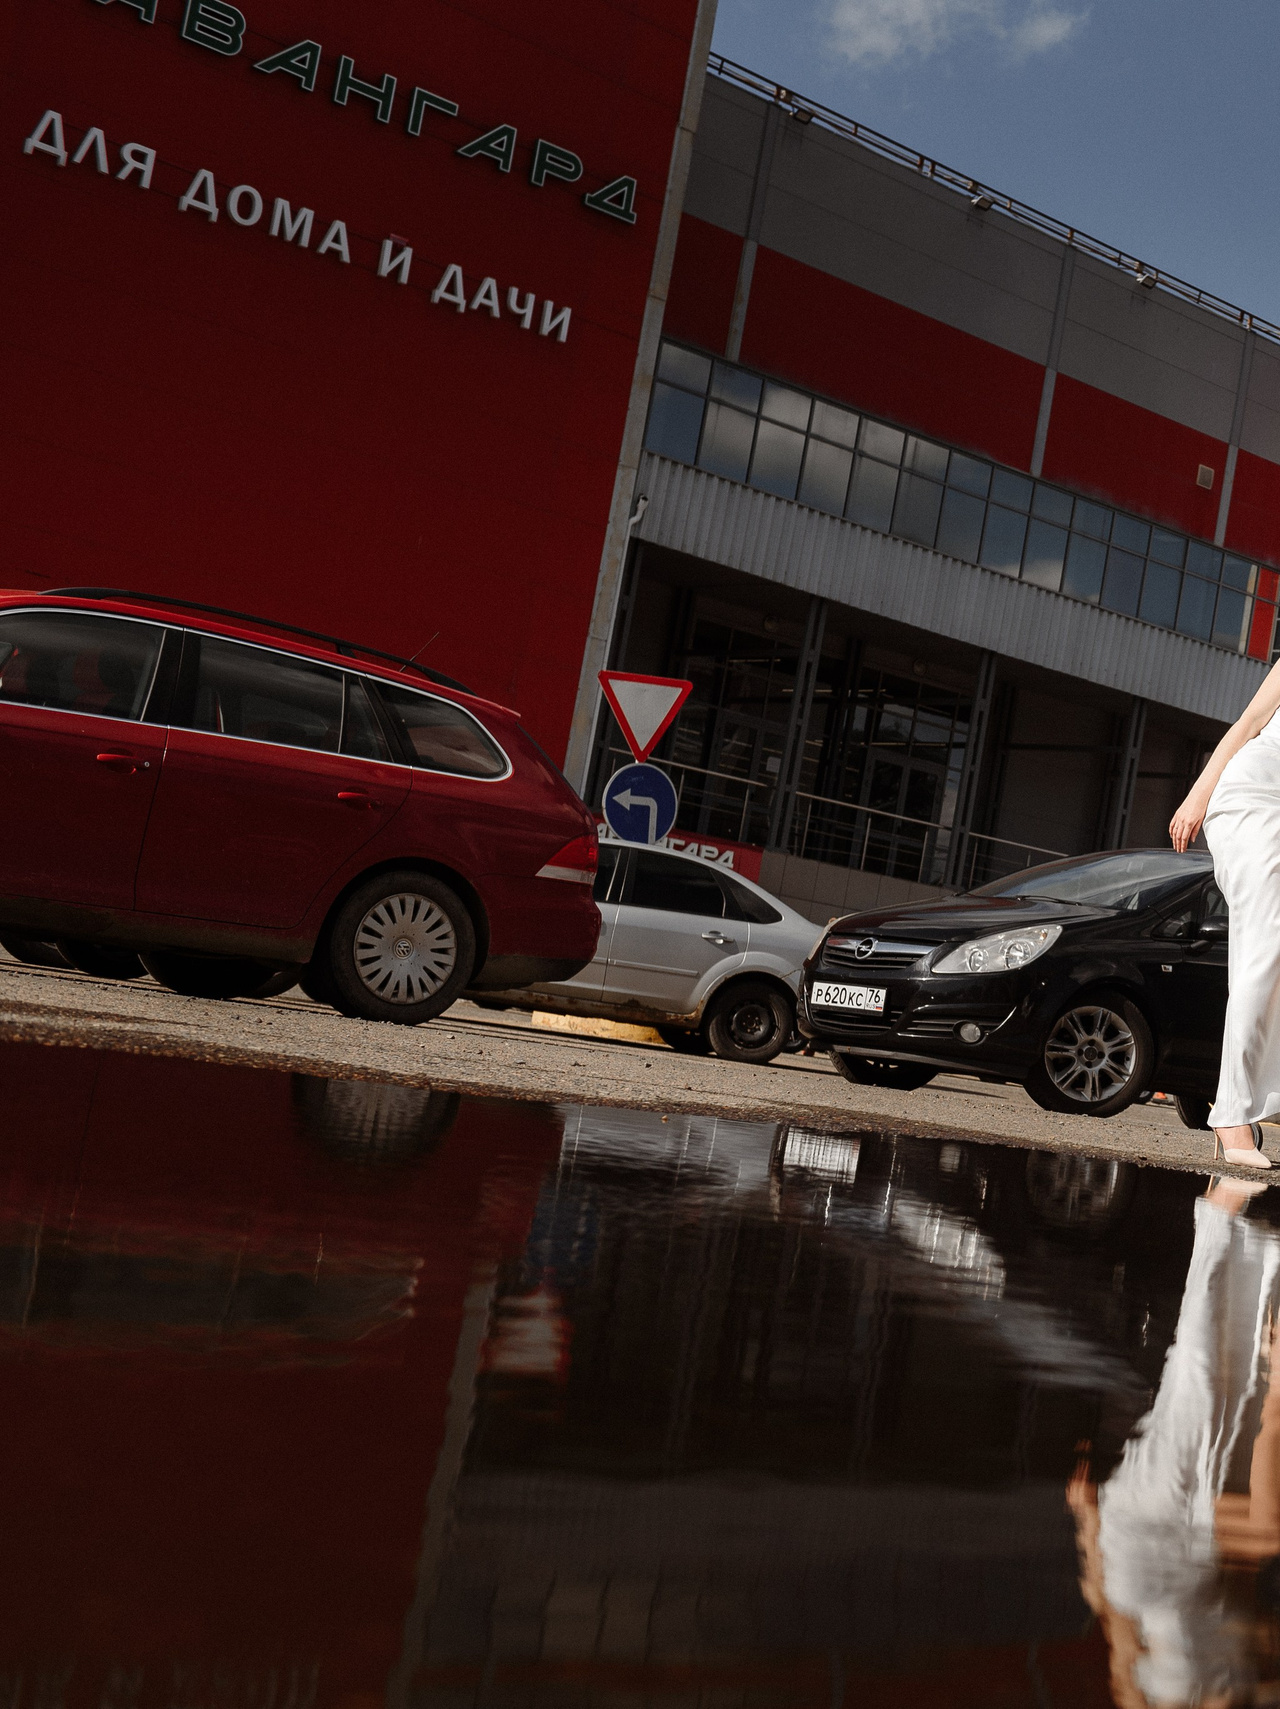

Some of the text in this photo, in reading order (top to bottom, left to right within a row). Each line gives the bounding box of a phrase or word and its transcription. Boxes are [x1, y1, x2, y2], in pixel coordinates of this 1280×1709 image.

[23, 109, 157, 189] ДЛЯ
[177, 168, 351, 264] ДОМА
[431, 263, 572, 343] ДАЧИ
[868, 989, 881, 1004] 76
